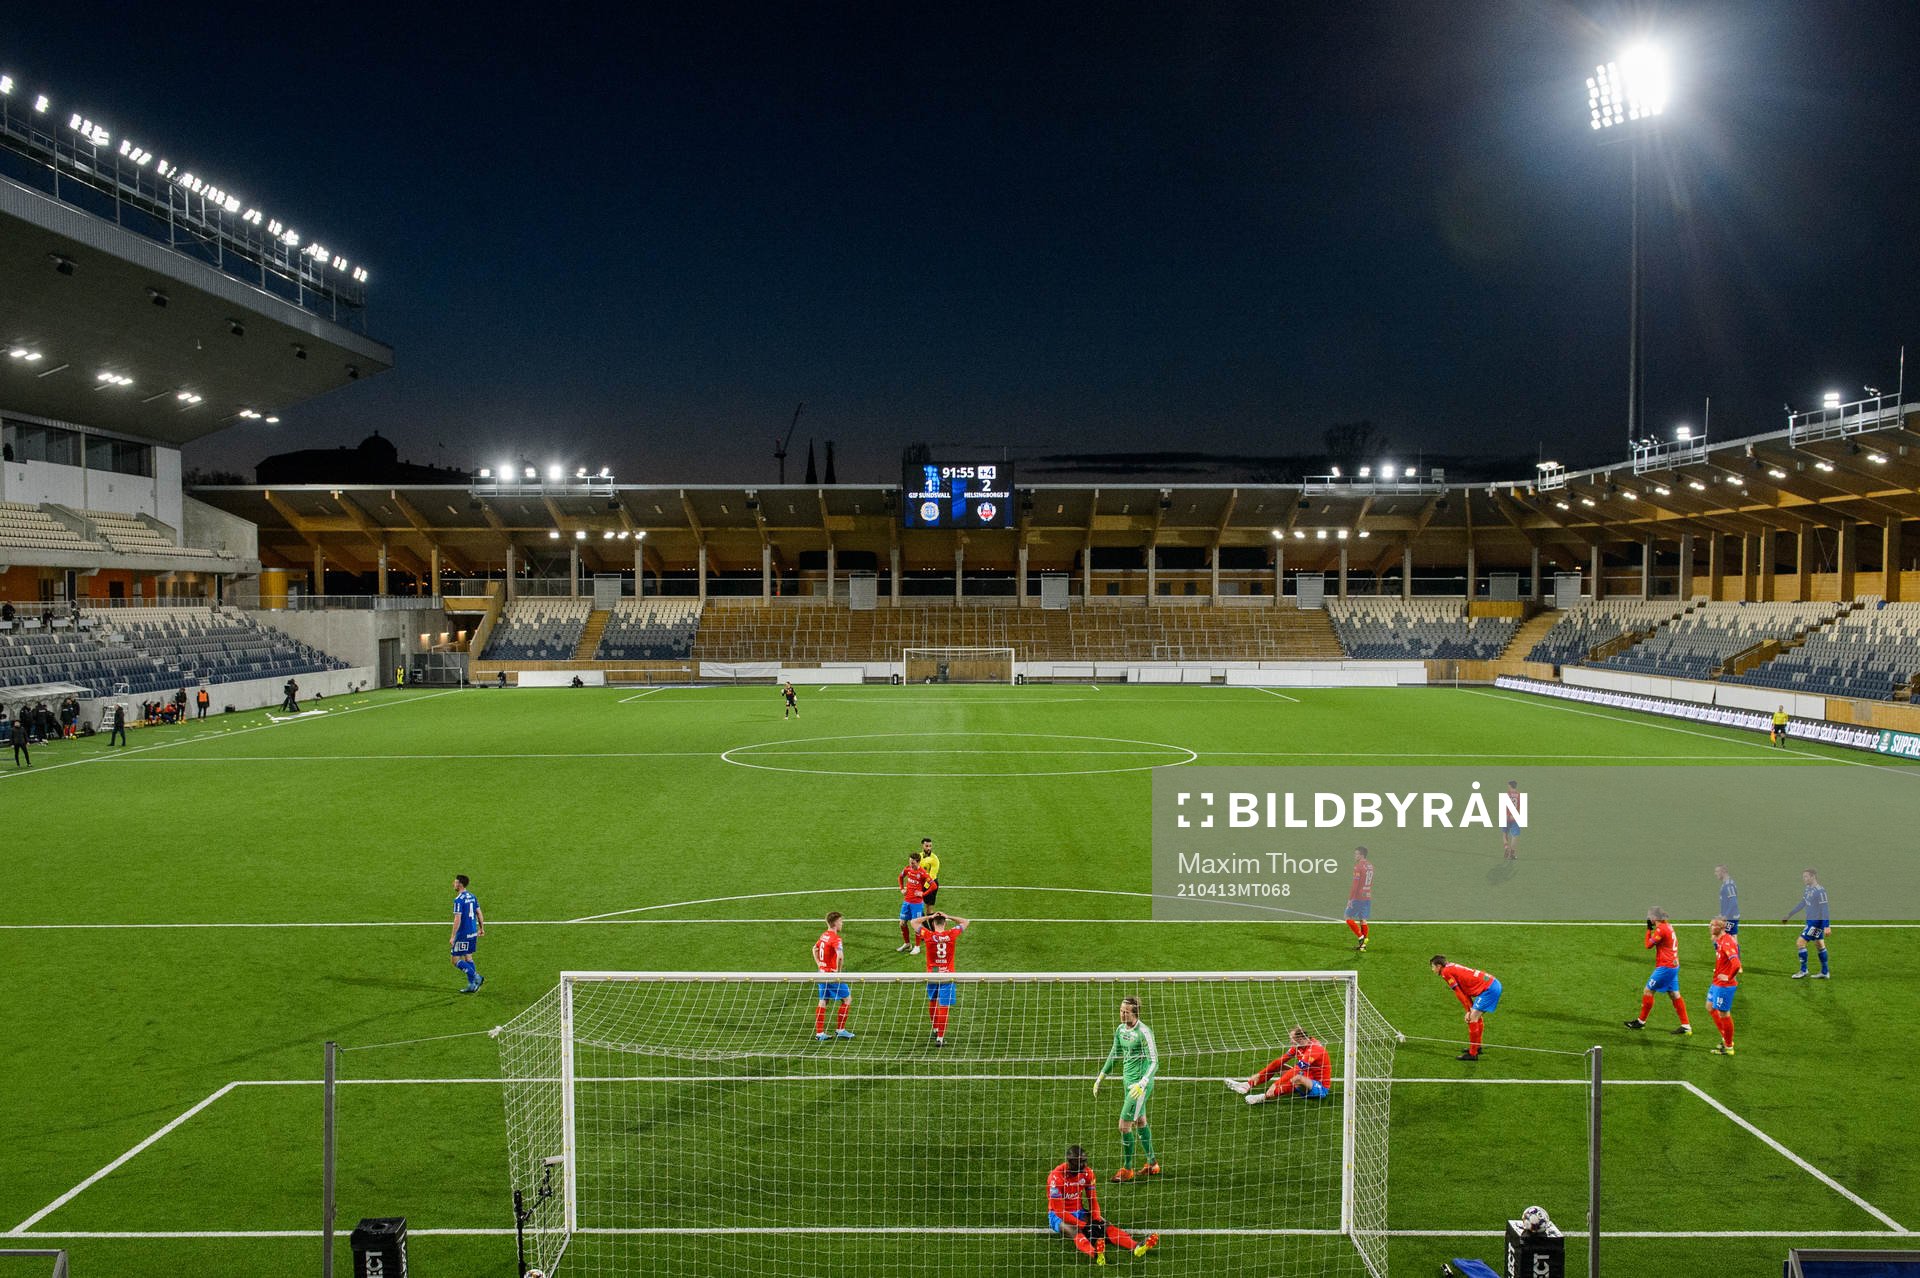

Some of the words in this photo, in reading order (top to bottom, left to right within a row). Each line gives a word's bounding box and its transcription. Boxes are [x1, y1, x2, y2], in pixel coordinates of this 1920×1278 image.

[942, 467, 974, 478] 91:55
[980, 467, 994, 477] +4
[925, 480, 933, 492] 1
[982, 480, 991, 492] 2
[468, 902, 475, 920] 4
[819, 941, 825, 960] 6
[936, 942, 947, 958] 8
